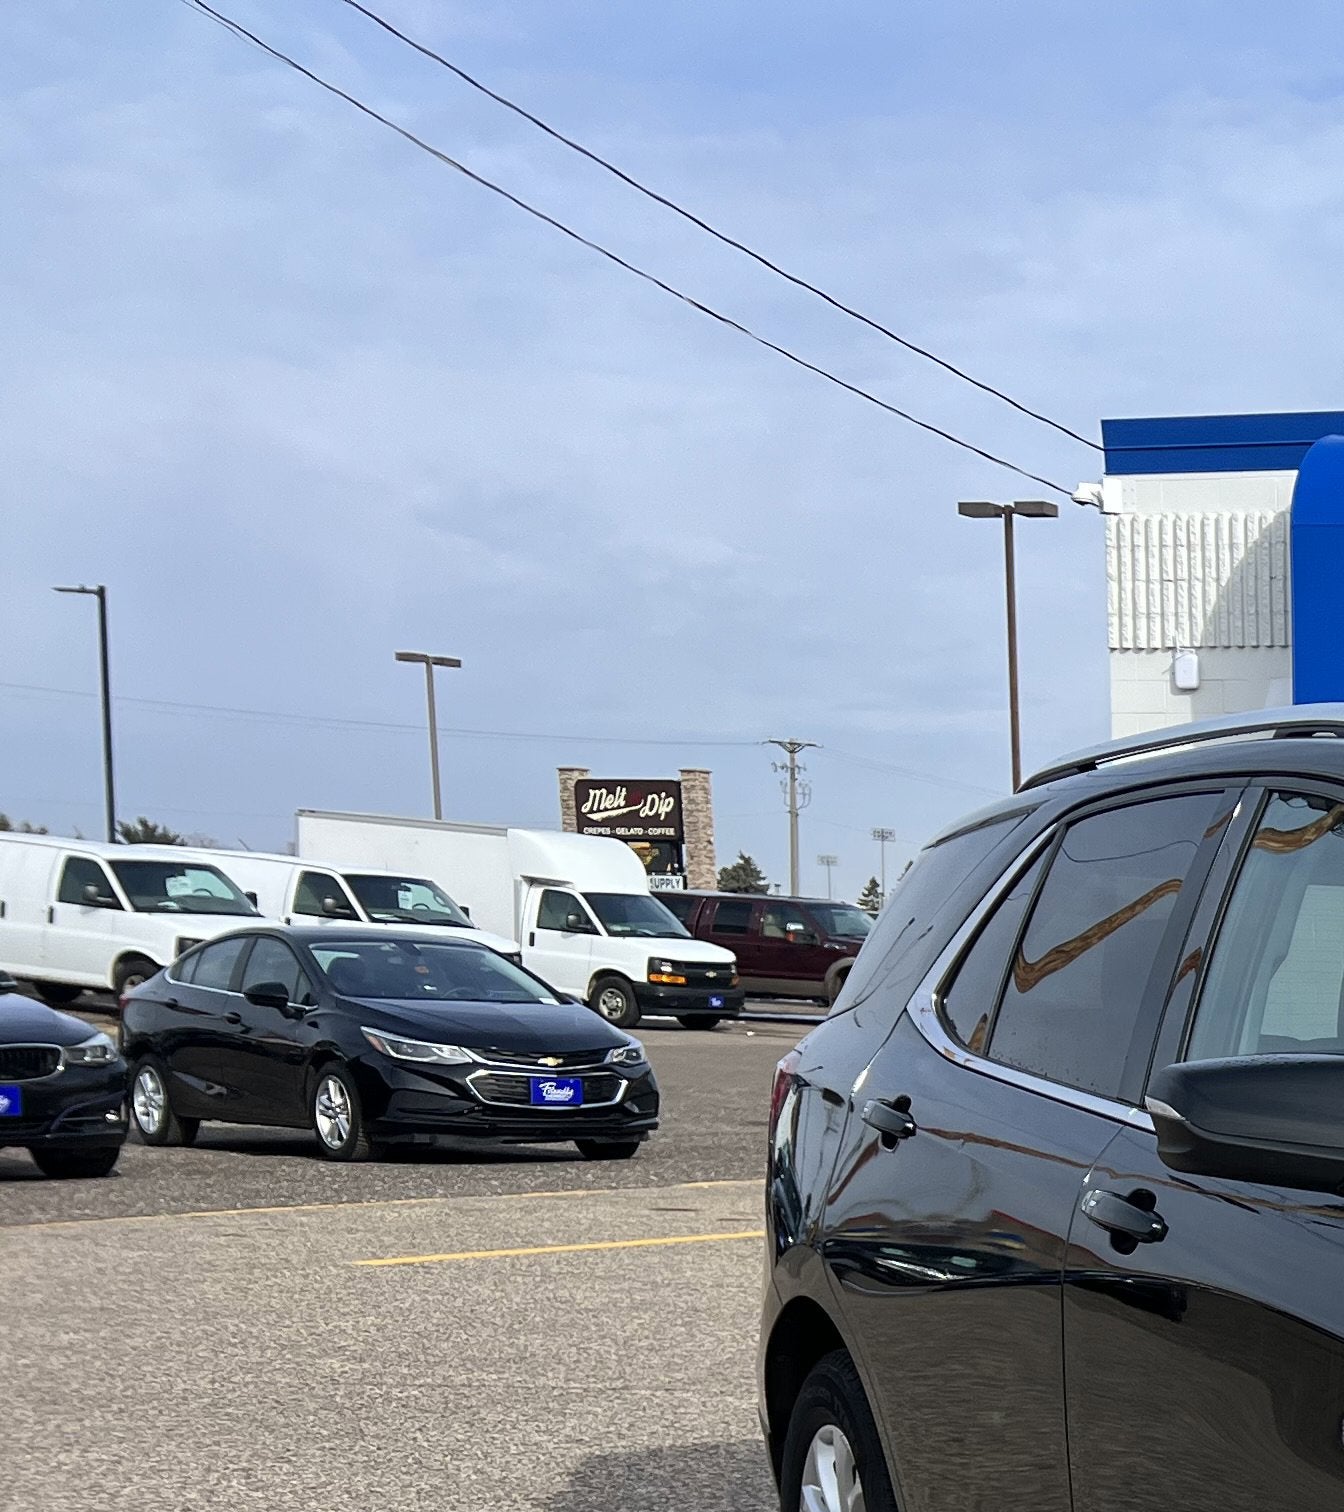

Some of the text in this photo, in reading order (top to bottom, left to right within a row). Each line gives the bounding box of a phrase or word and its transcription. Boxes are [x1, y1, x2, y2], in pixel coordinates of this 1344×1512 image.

[581, 786, 674, 820] Melt Dip
[583, 827, 675, 836] CREPES GELATO COFFEE
